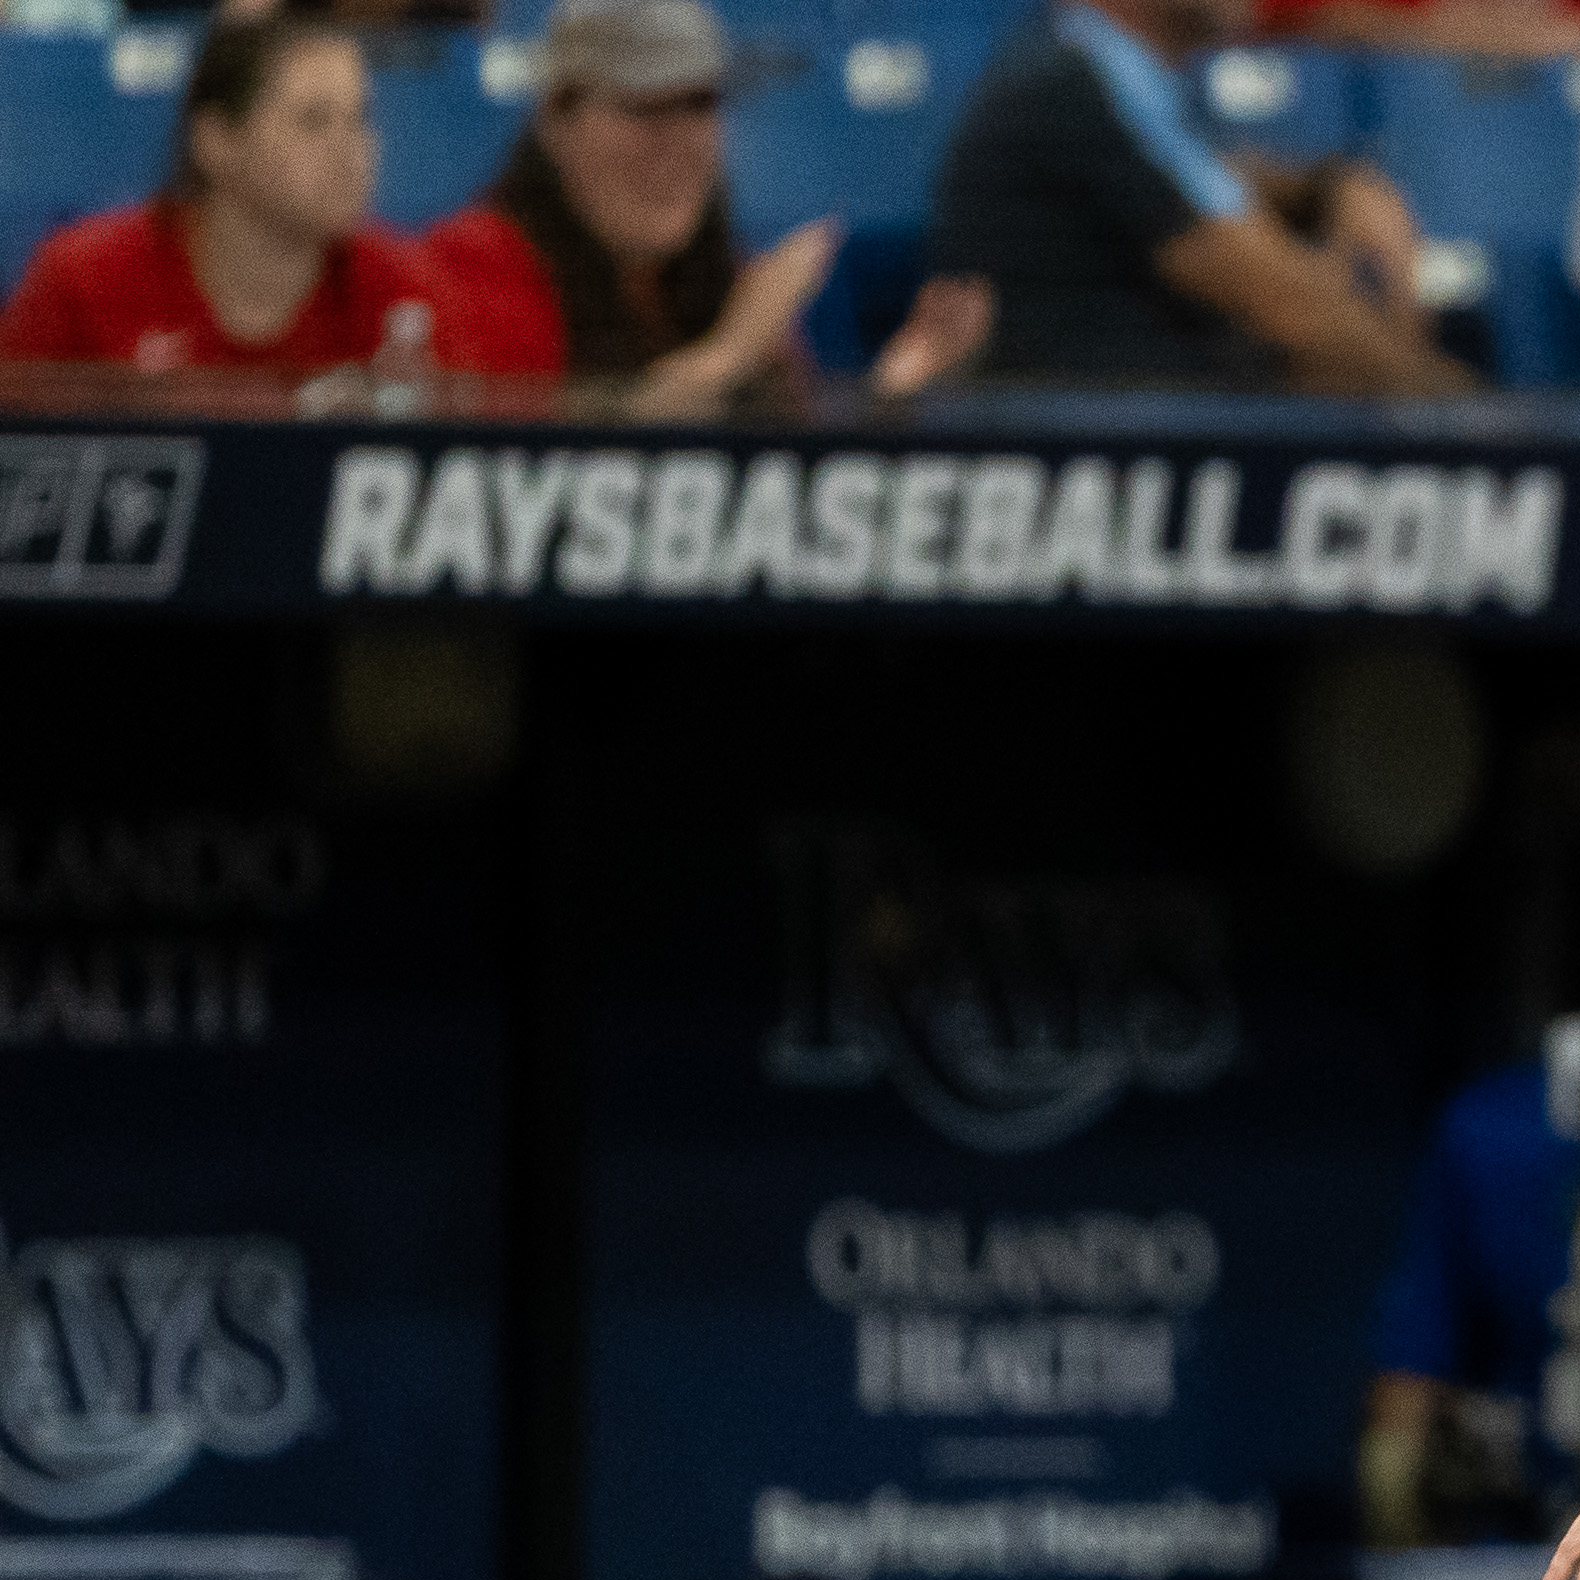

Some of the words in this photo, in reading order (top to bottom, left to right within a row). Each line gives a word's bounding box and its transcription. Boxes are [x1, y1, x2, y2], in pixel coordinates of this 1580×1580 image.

[320, 445, 1562, 615] RAYSBASEBALL.COM
[806, 1196, 1222, 1312] ORLANDO
[855, 1312, 1178, 1418] HEALTH
